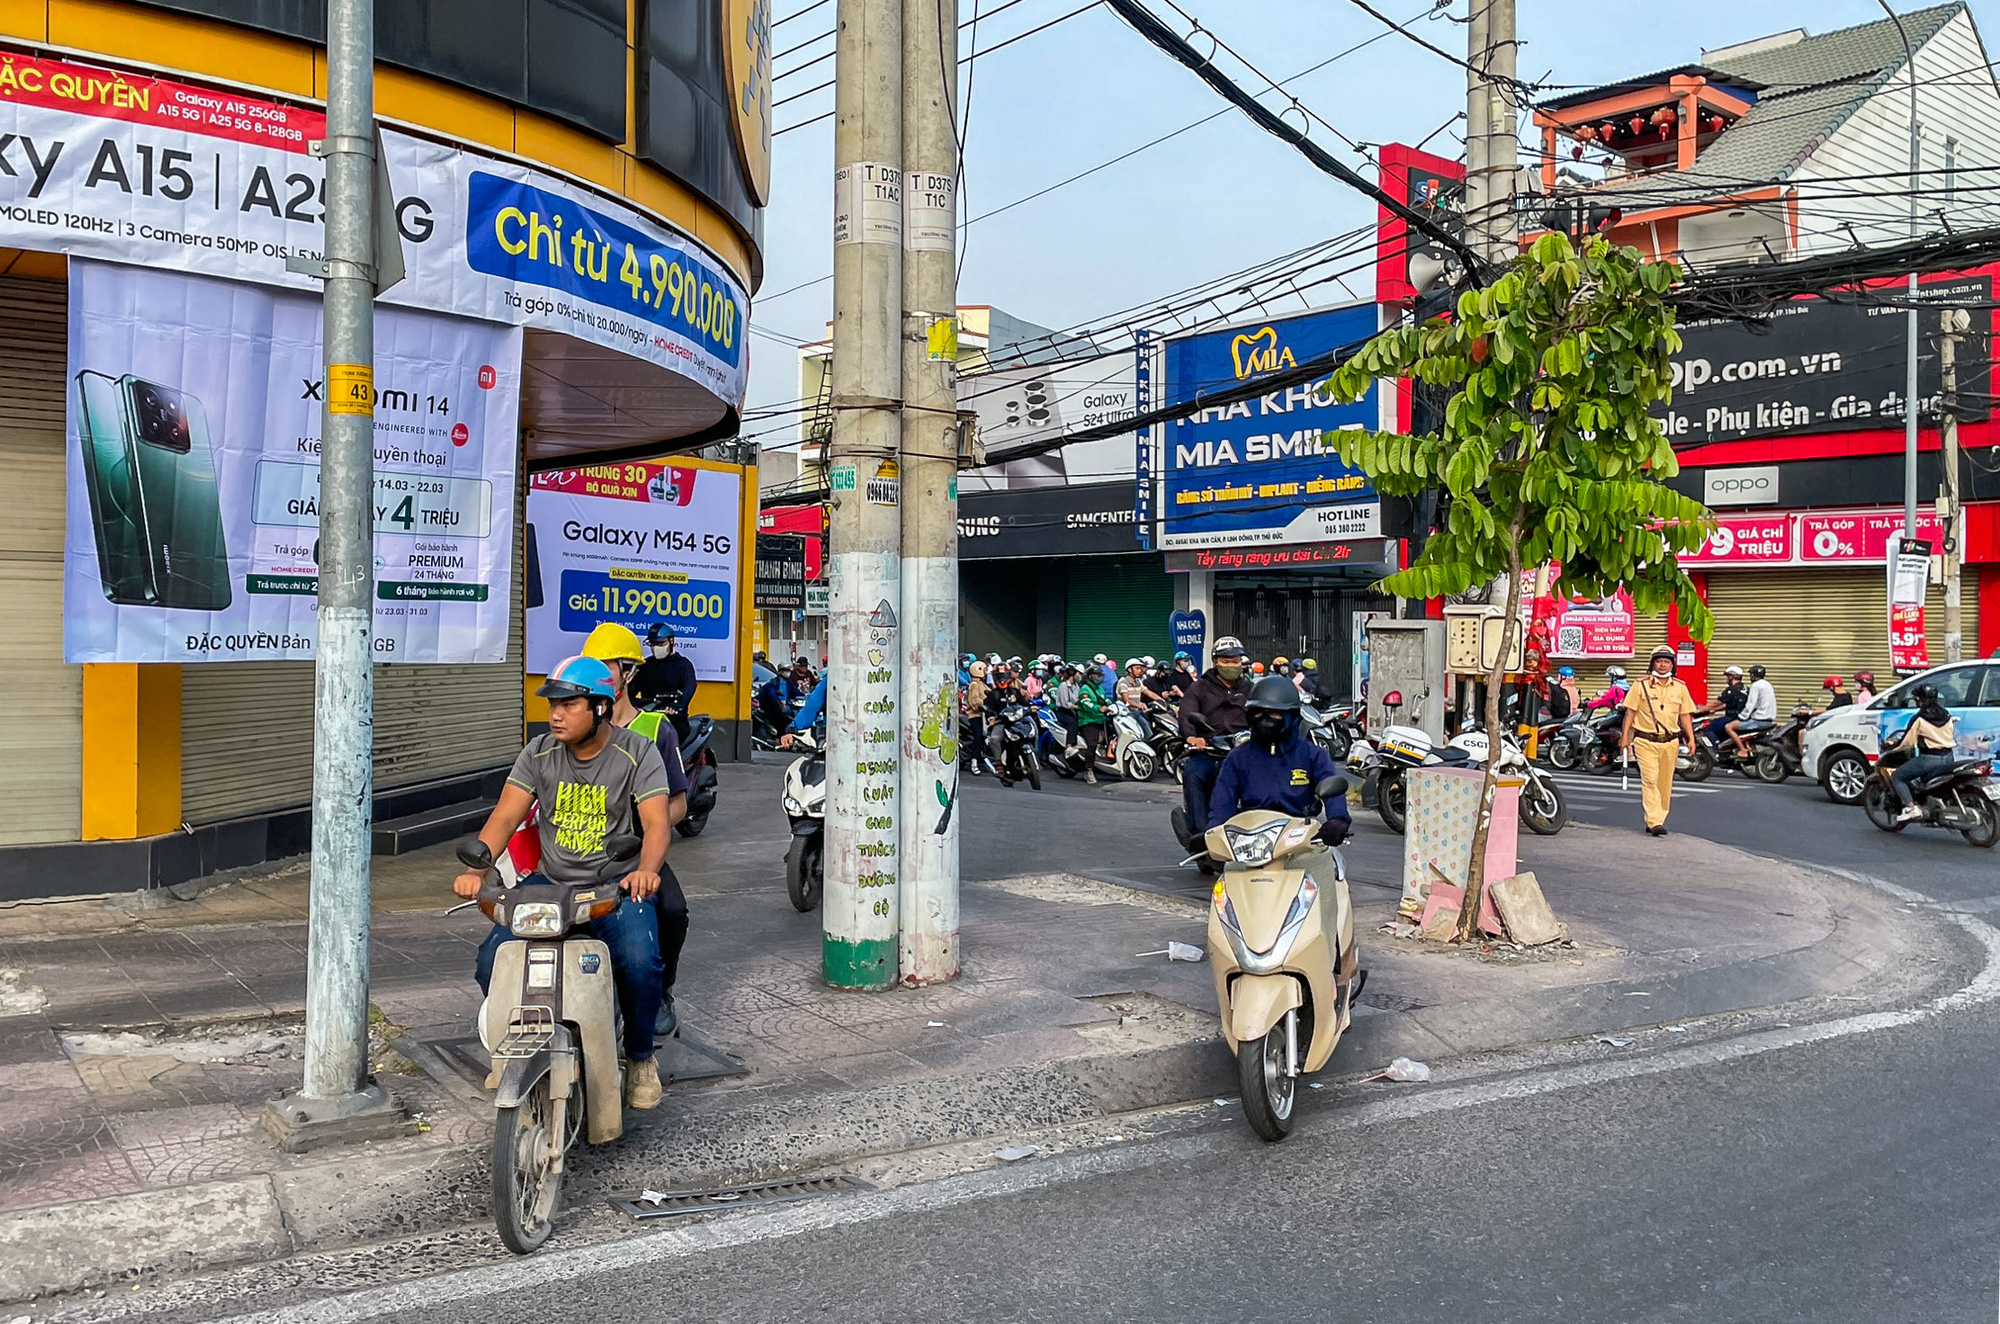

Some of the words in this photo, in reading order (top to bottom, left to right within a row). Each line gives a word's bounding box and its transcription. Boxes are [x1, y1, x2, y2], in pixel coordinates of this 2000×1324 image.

[50, 71, 149, 112] QUYỀN
[175, 91, 223, 113] Galaxy
[225, 101, 247, 115] A15
[248, 105, 287, 123] 256GB
[157, 104, 180, 118] A15
[181, 107, 200, 121] 5G
[208, 113, 232, 126] A25
[234, 117, 252, 131] 5G
[254, 120, 303, 142] 8-128GB
[85, 138, 194, 201] A15
[240, 164, 326, 225] A2
[865, 165, 874, 181] T
[912, 175, 920, 189] T
[928, 176, 952, 192] D37S
[874, 185, 900, 202] T1AC
[925, 193, 945, 208] T1C
[64, 213, 114, 234] 120Hz
[126, 222, 136, 236] 3
[140, 225, 212, 249] Camera
[216, 236, 259, 255] 50MP
[262, 244, 287, 260] OIS
[495, 207, 563, 267] Chỉ
[570, 228, 610, 283] từ
[620, 243, 735, 349] 4.990.000
[503, 291, 522, 308] Trả
[525, 296, 555, 317] góp
[557, 303, 571, 317] 0%
[571, 309, 585, 324] chỉ
[597, 316, 648, 347] 20.000/ngày
[351, 384, 368, 400] 43
[1084, 392, 1128, 409] Galaxy
[426, 395, 449, 416] 14
[1084, 413, 1104, 428] S24
[1106, 411, 1136, 424] Ultra
[1707, 406, 1750, 436] Phụ
[1757, 402, 1809, 430] kiện
[1831, 394, 1872, 420] Gia
[373, 422, 425, 435] ENGINEERED
[429, 425, 448, 437] WITH
[414, 451, 447, 467] thoại
[1139, 436, 1150, 470] MIA
[1177, 439, 1238, 469] MIA
[624, 465, 647, 484] 30
[379, 479, 409, 492] 14.03
[417, 483, 444, 494] 22.03
[586, 482, 599, 495] BỘ
[601, 482, 620, 496] QUÀ
[621, 486, 637, 499] XỊN
[1176, 489, 1200, 505] RĂNG
[1259, 482, 1299, 498] IMPLANT
[1306, 475, 1336, 494] NIỀNG
[1711, 478, 1769, 493] oppo
[391, 495, 414, 531] 4
[421, 510, 459, 527] TRIỆU
[1139, 478, 1150, 535] SMILE
[1318, 509, 1370, 523] HOTLINE
[1869, 518, 1890, 529] TRẢ
[1325, 525, 1337, 534] 085
[1338, 524, 1350, 533] 380
[1350, 523, 1366, 533] 2222
[1809, 520, 1830, 531] TRẢ
[1832, 519, 1855, 531] GÓP
[563, 521, 648, 554] Galaxy
[654, 529, 697, 552] M54
[702, 534, 731, 555] 5G
[1710, 527, 1734, 556] 9
[1737, 525, 1759, 538] GIÁ
[1762, 525, 1783, 538] CHỈ
[1813, 531, 1854, 557] 0%
[274, 544, 289, 556] Trả
[290, 546, 308, 559] góp
[1738, 540, 1783, 557] TRIỆU
[408, 555, 464, 569] PREMIUM
[783, 557, 802, 579] BÌNH
[414, 571, 425, 580] 24
[426, 569, 454, 580] THÁNG
[626, 570, 646, 580] QUYỀN
[257, 580, 269, 590] Trả
[396, 585, 402, 596] 6
[404, 586, 427, 598] tháng
[568, 593, 598, 611] Giá
[602, 587, 723, 619] 11.990.000
[384, 607, 405, 616] 23.03
[409, 608, 428, 617] 31.03
[187, 632, 222, 653] ĐẶC
[226, 629, 278, 650] QUYỀN
[281, 632, 310, 650] Bản
[557, 781, 607, 815] HIGH
[866, 816, 893, 830] GIAO
